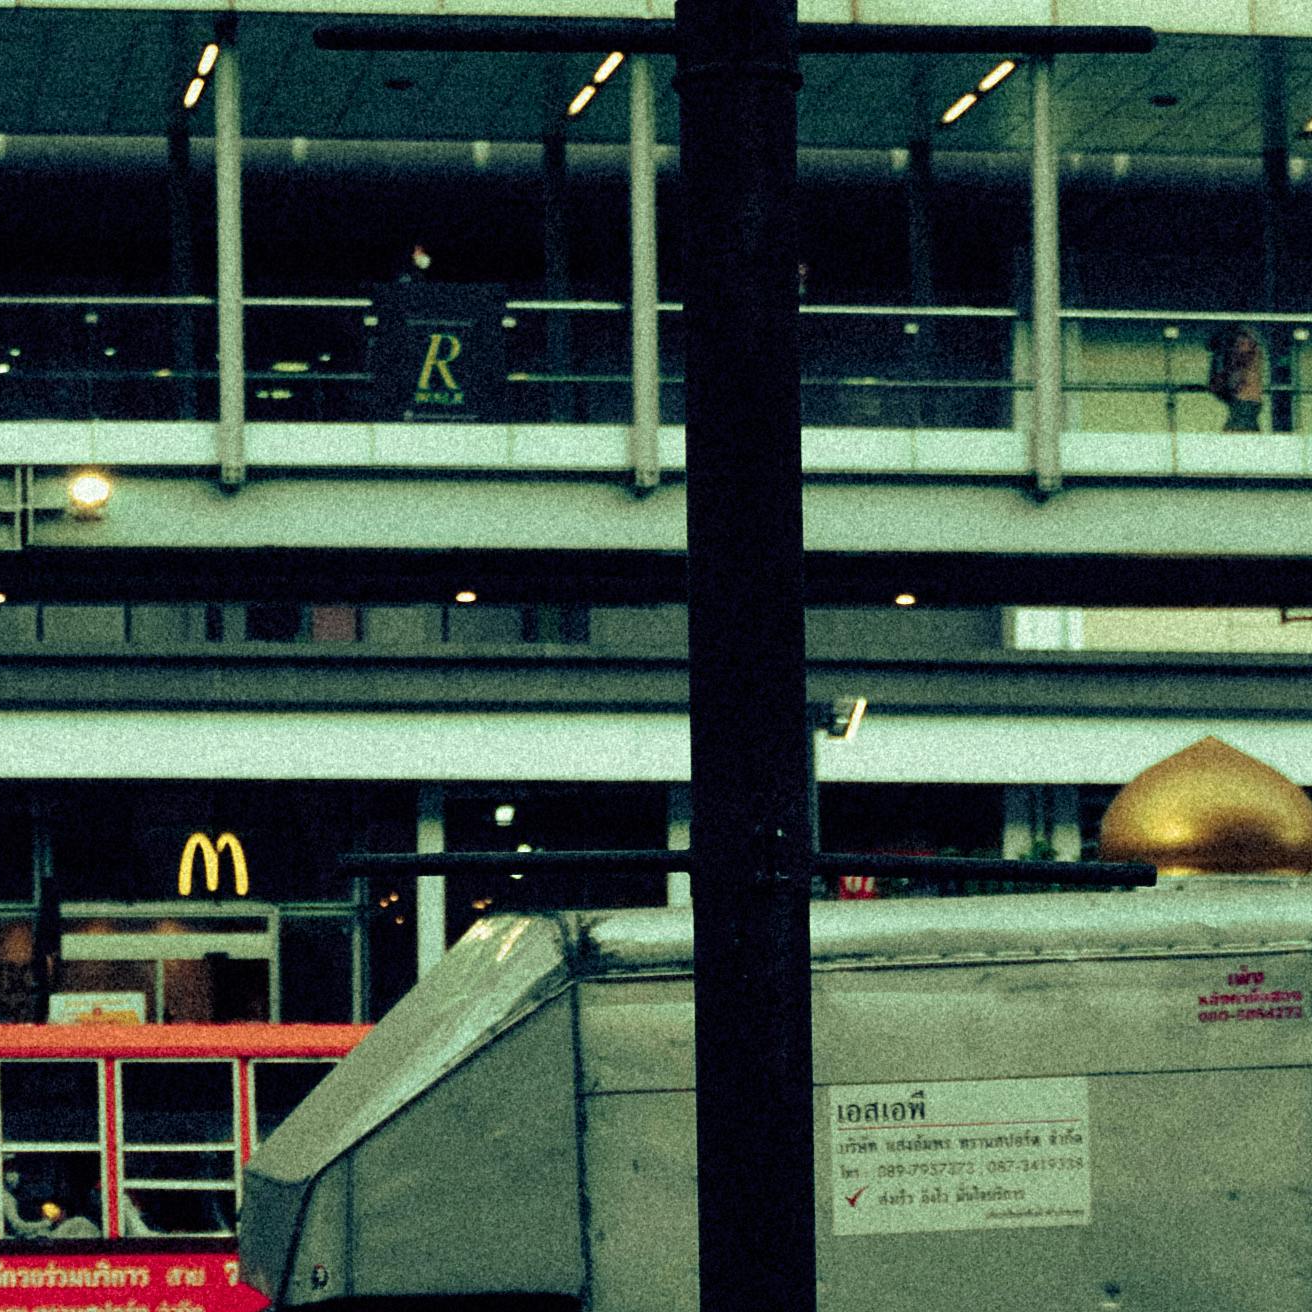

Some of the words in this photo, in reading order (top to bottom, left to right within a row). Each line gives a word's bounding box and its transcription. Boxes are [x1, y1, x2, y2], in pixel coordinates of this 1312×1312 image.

[418, 334, 461, 389] R
[837, 1090, 926, 1124] เอสเอพี
